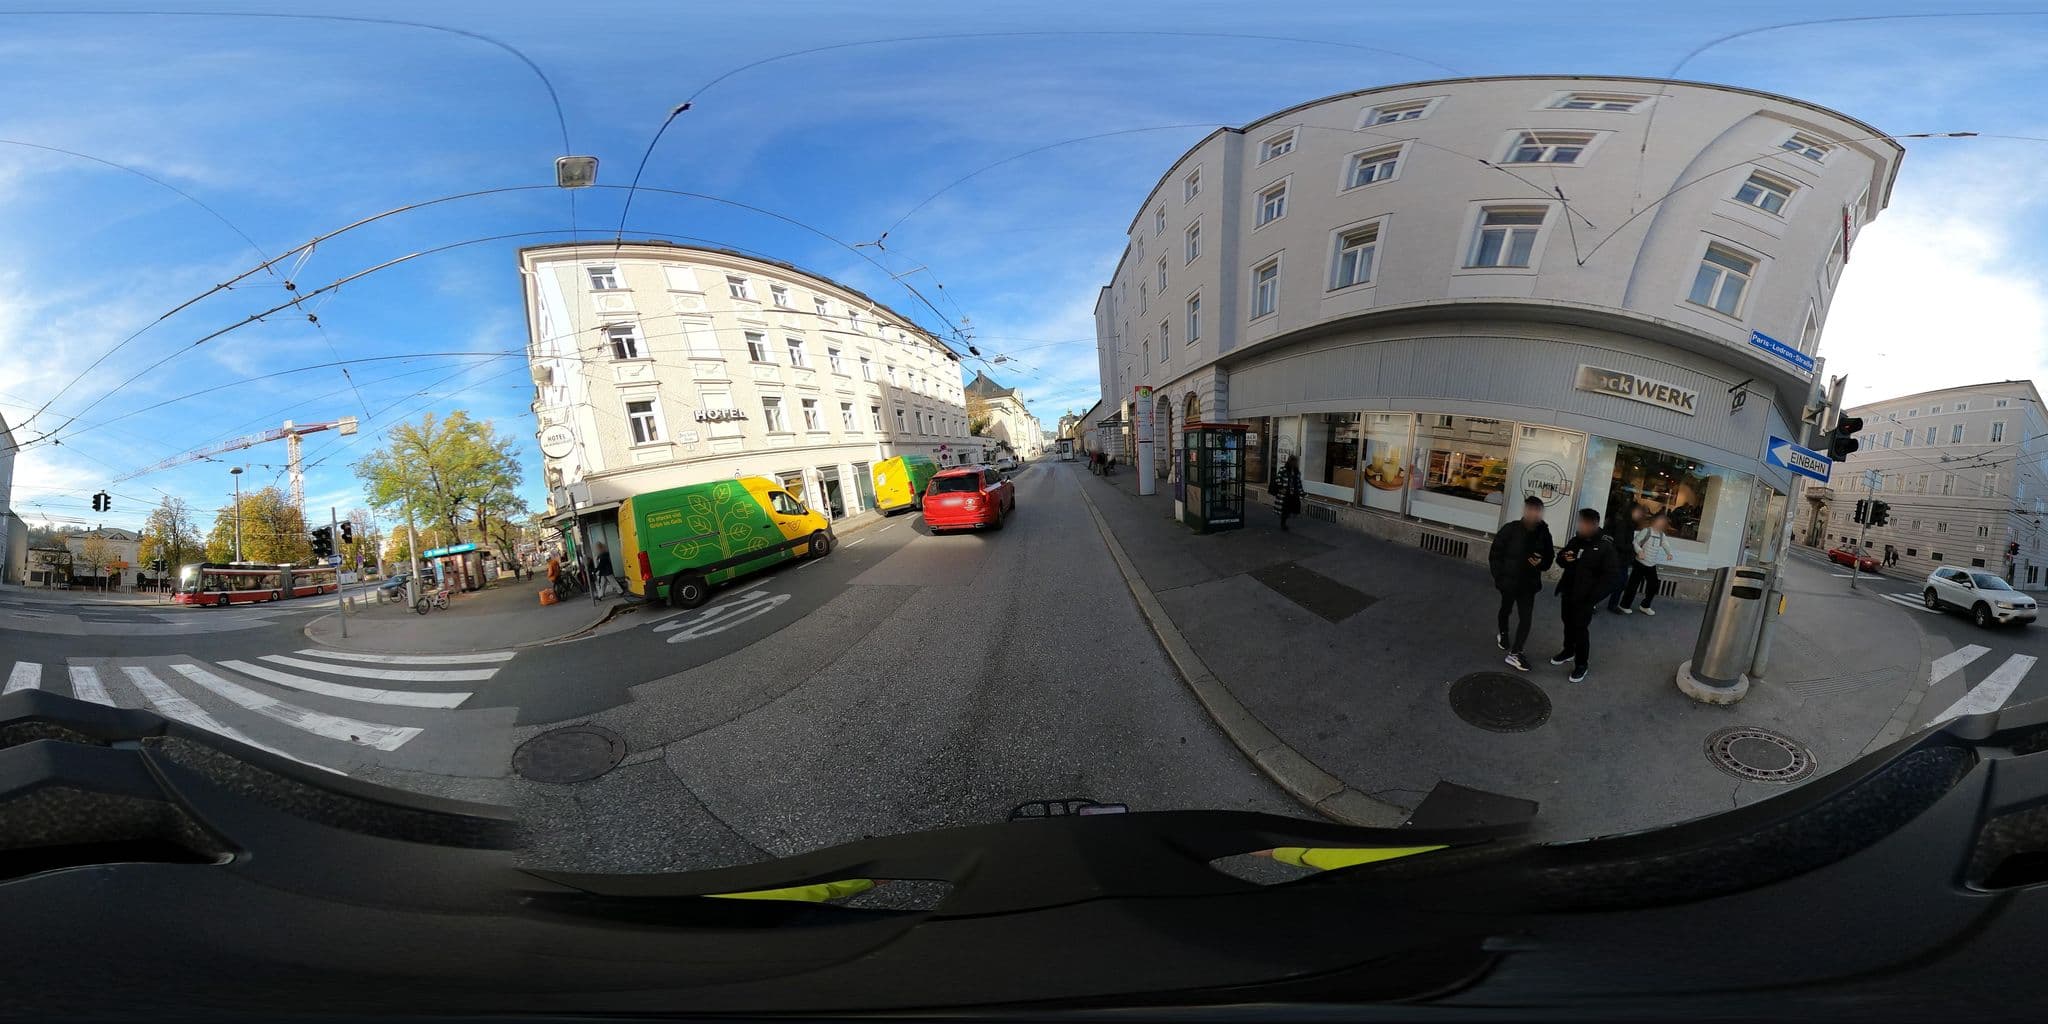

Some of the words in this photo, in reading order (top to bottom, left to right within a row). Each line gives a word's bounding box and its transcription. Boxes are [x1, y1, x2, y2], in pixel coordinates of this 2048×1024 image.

[1752, 334, 1813, 369] Paris-Lodron-Straße
[1636, 379, 1696, 410] WERK
[693, 408, 747, 422] HOTEL
[547, 433, 567, 442] HOTEL
[1790, 452, 1826, 474] EINBAHN
[1527, 479, 1559, 493] VITAMINE
